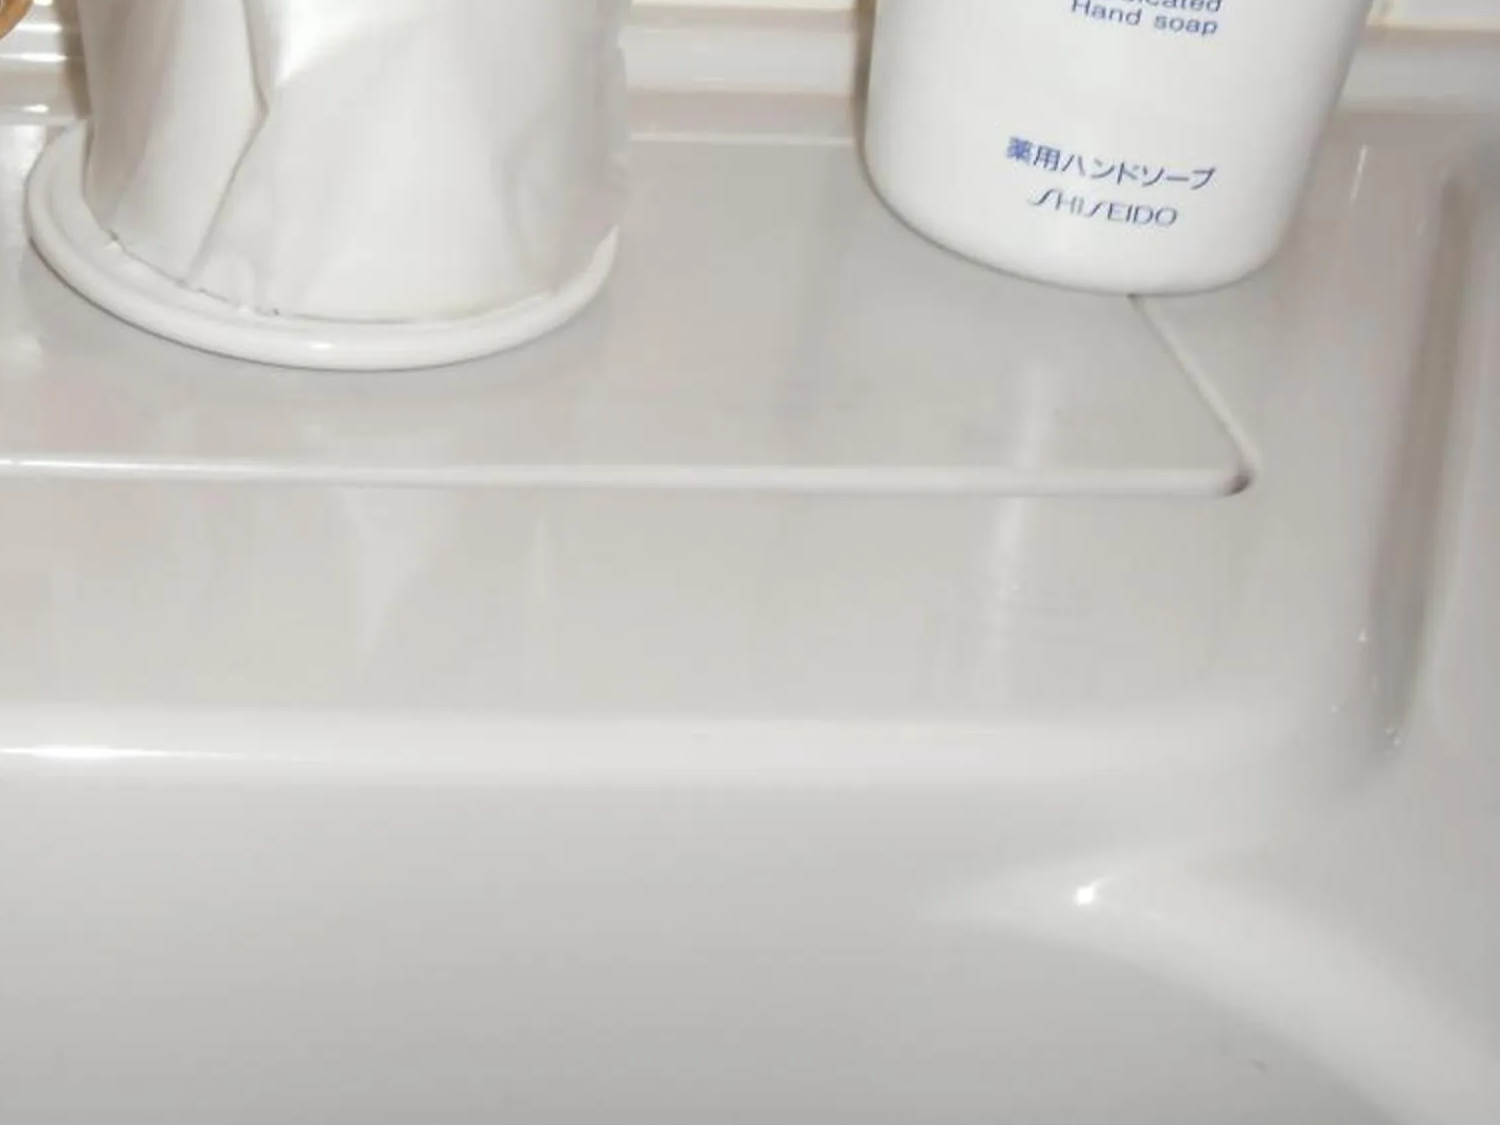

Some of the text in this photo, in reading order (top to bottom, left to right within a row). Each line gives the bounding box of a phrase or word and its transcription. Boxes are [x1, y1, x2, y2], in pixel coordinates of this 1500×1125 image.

[1153, 14, 1219, 36] soap
[1006, 135, 1217, 190] 薬用ハンドソープ
[1028, 187, 1179, 227] SHISEIDO
